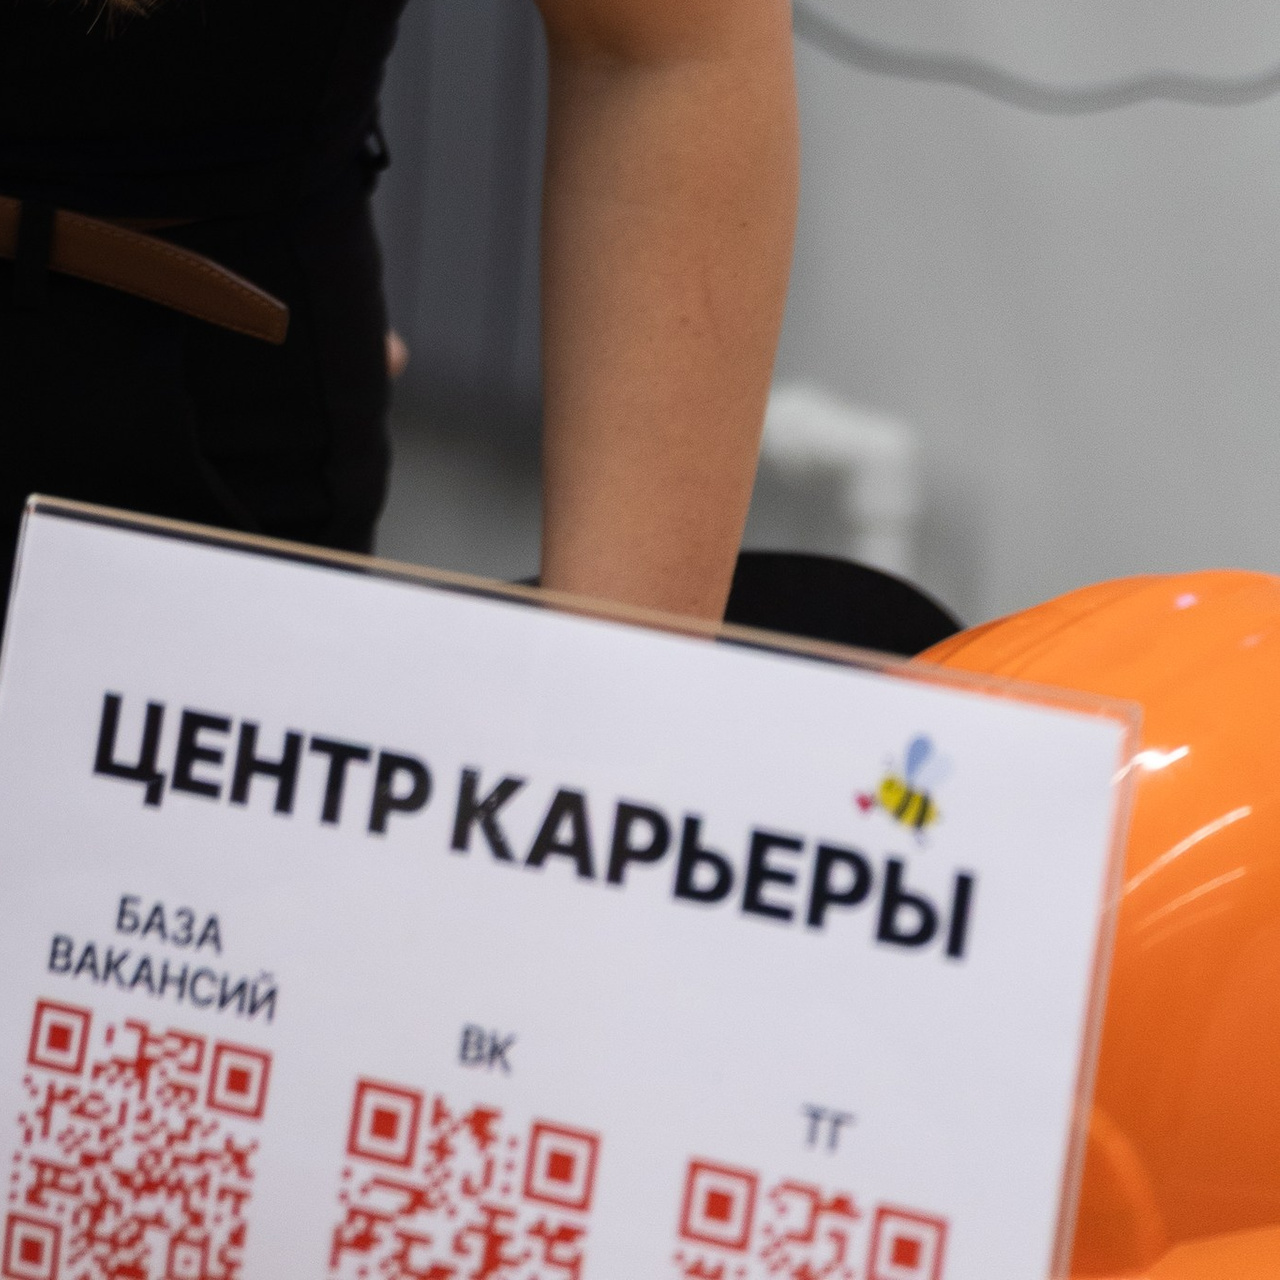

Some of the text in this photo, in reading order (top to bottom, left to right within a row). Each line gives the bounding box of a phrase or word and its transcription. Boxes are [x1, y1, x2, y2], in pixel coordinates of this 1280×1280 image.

[91, 691, 976, 960] ЦЕНТР КАРЬЕРЫ
[114, 893, 223, 954] БАЗА
[46, 933, 279, 1022] ВАКАНСИЙ
[802, 1102, 856, 1152] ТГ
